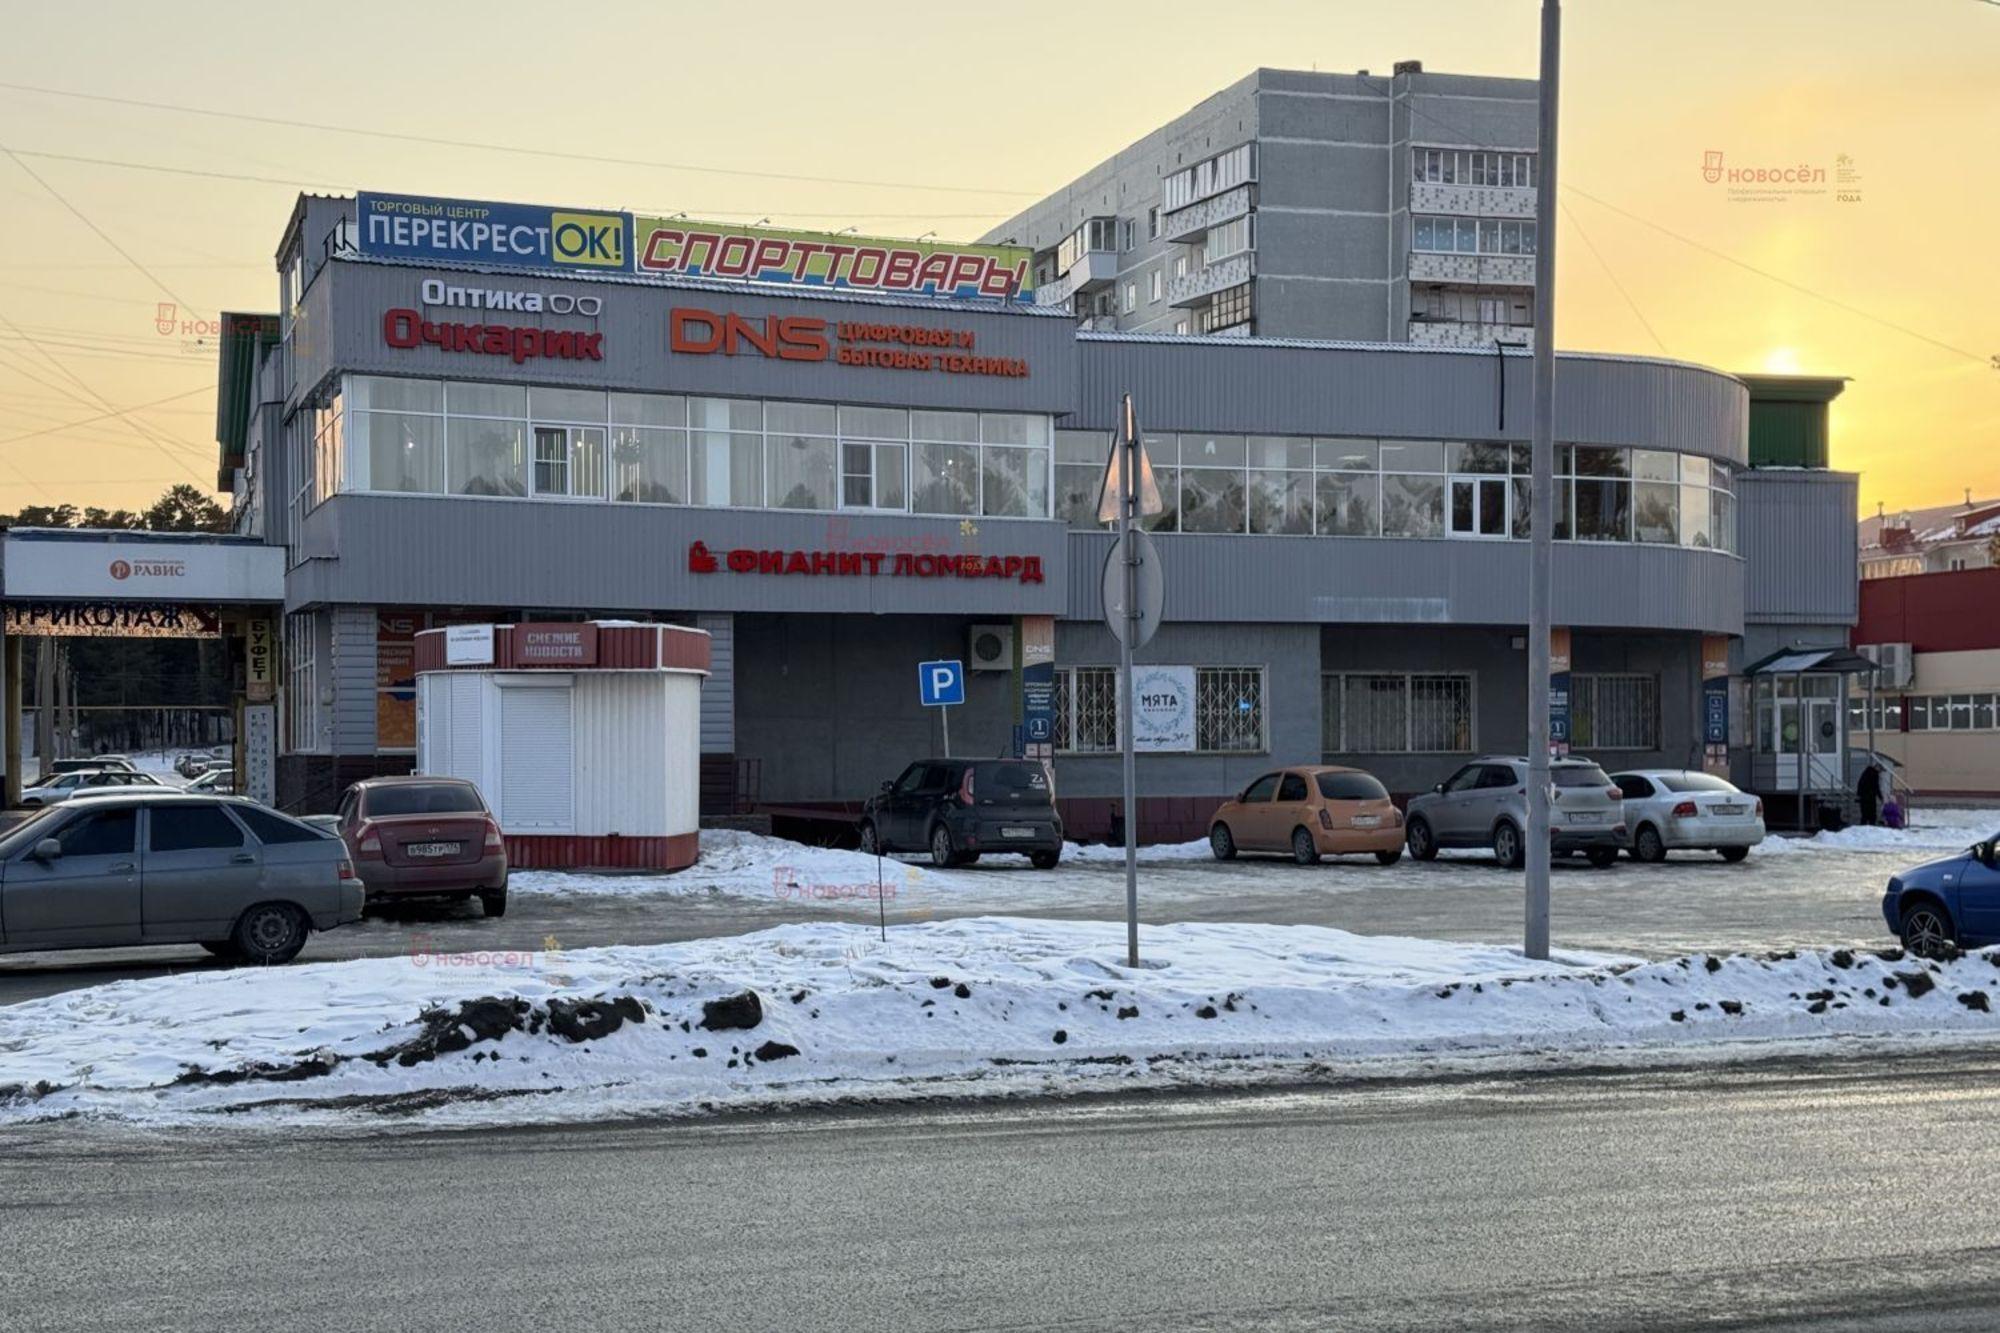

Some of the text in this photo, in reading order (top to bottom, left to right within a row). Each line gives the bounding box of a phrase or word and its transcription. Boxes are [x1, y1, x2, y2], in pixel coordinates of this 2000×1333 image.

[370, 200, 490, 220] ТОРГОВЫЙ ЦЕНТР
[641, 228, 1030, 298] СПОРТТОВАРЫ
[422, 279, 543, 313] Оптика
[384, 308, 603, 364] Очкарик
[670, 308, 829, 362] DNS
[837, 320, 975, 349] ЦИФРОВАЯ И
[837, 347, 1030, 378] БЫТОВАЯ ТЕХНИКА
[134, 565, 185, 576] РАВИС
[726, 549, 1044, 584] ФИАНИТ ЛОМБАРД
[7, 603, 184, 627] ТРИКОТАЖ
[250, 621, 268, 680] БУФЕТ
[525, 645, 583, 657] НОВОСТИ
[931, 668, 954, 699] P
[1141, 694, 1178, 707] МЯТА
[1037, 720, 1042, 731] 1
